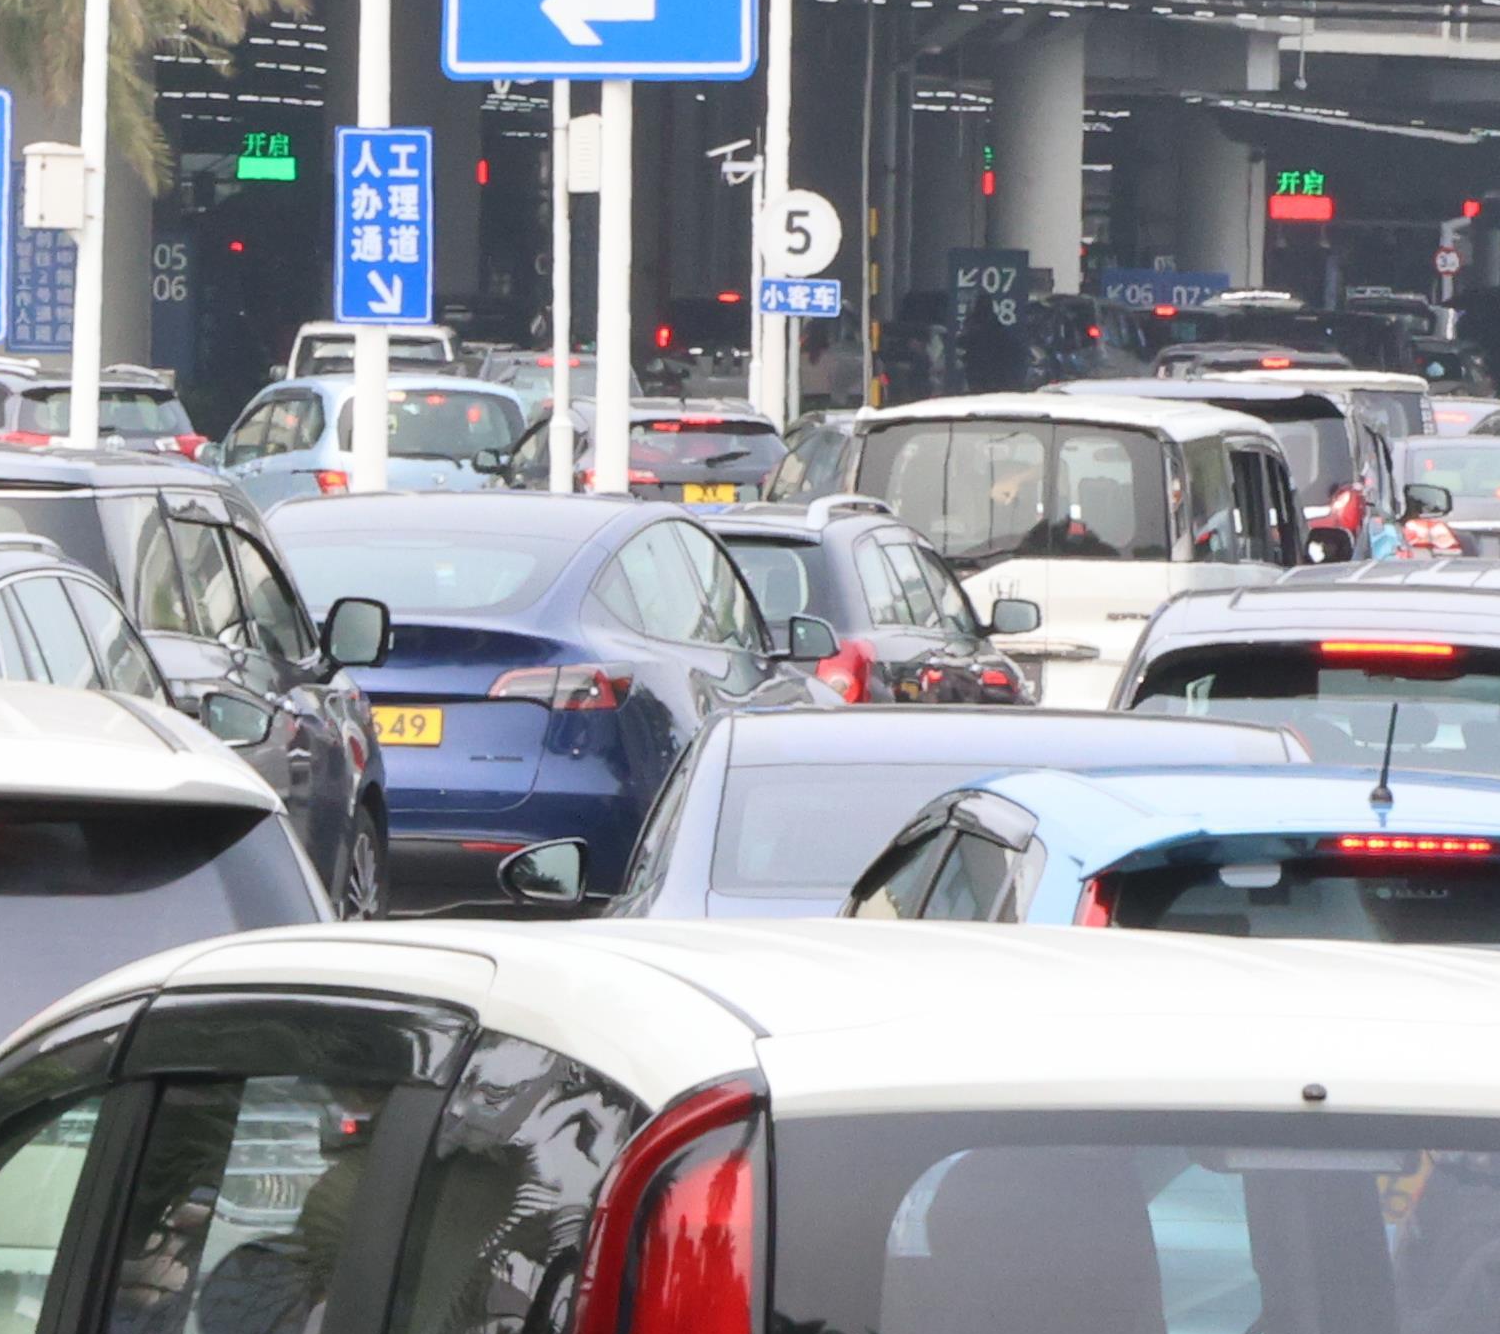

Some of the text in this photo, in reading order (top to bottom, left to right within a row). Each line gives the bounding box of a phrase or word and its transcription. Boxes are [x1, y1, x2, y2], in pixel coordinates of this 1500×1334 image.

[242, 133, 290, 157] 开启
[351, 140, 420, 179] 人工
[1276, 170, 1325, 195] 开启
[351, 182, 420, 221] 办理
[351, 225, 420, 263] 通道
[785, 210, 812, 255] 5
[154, 244, 188, 271] 05
[153, 275, 188, 302] 06
[981, 268, 1017, 294] 07
[762, 285, 837, 309] 小客车
